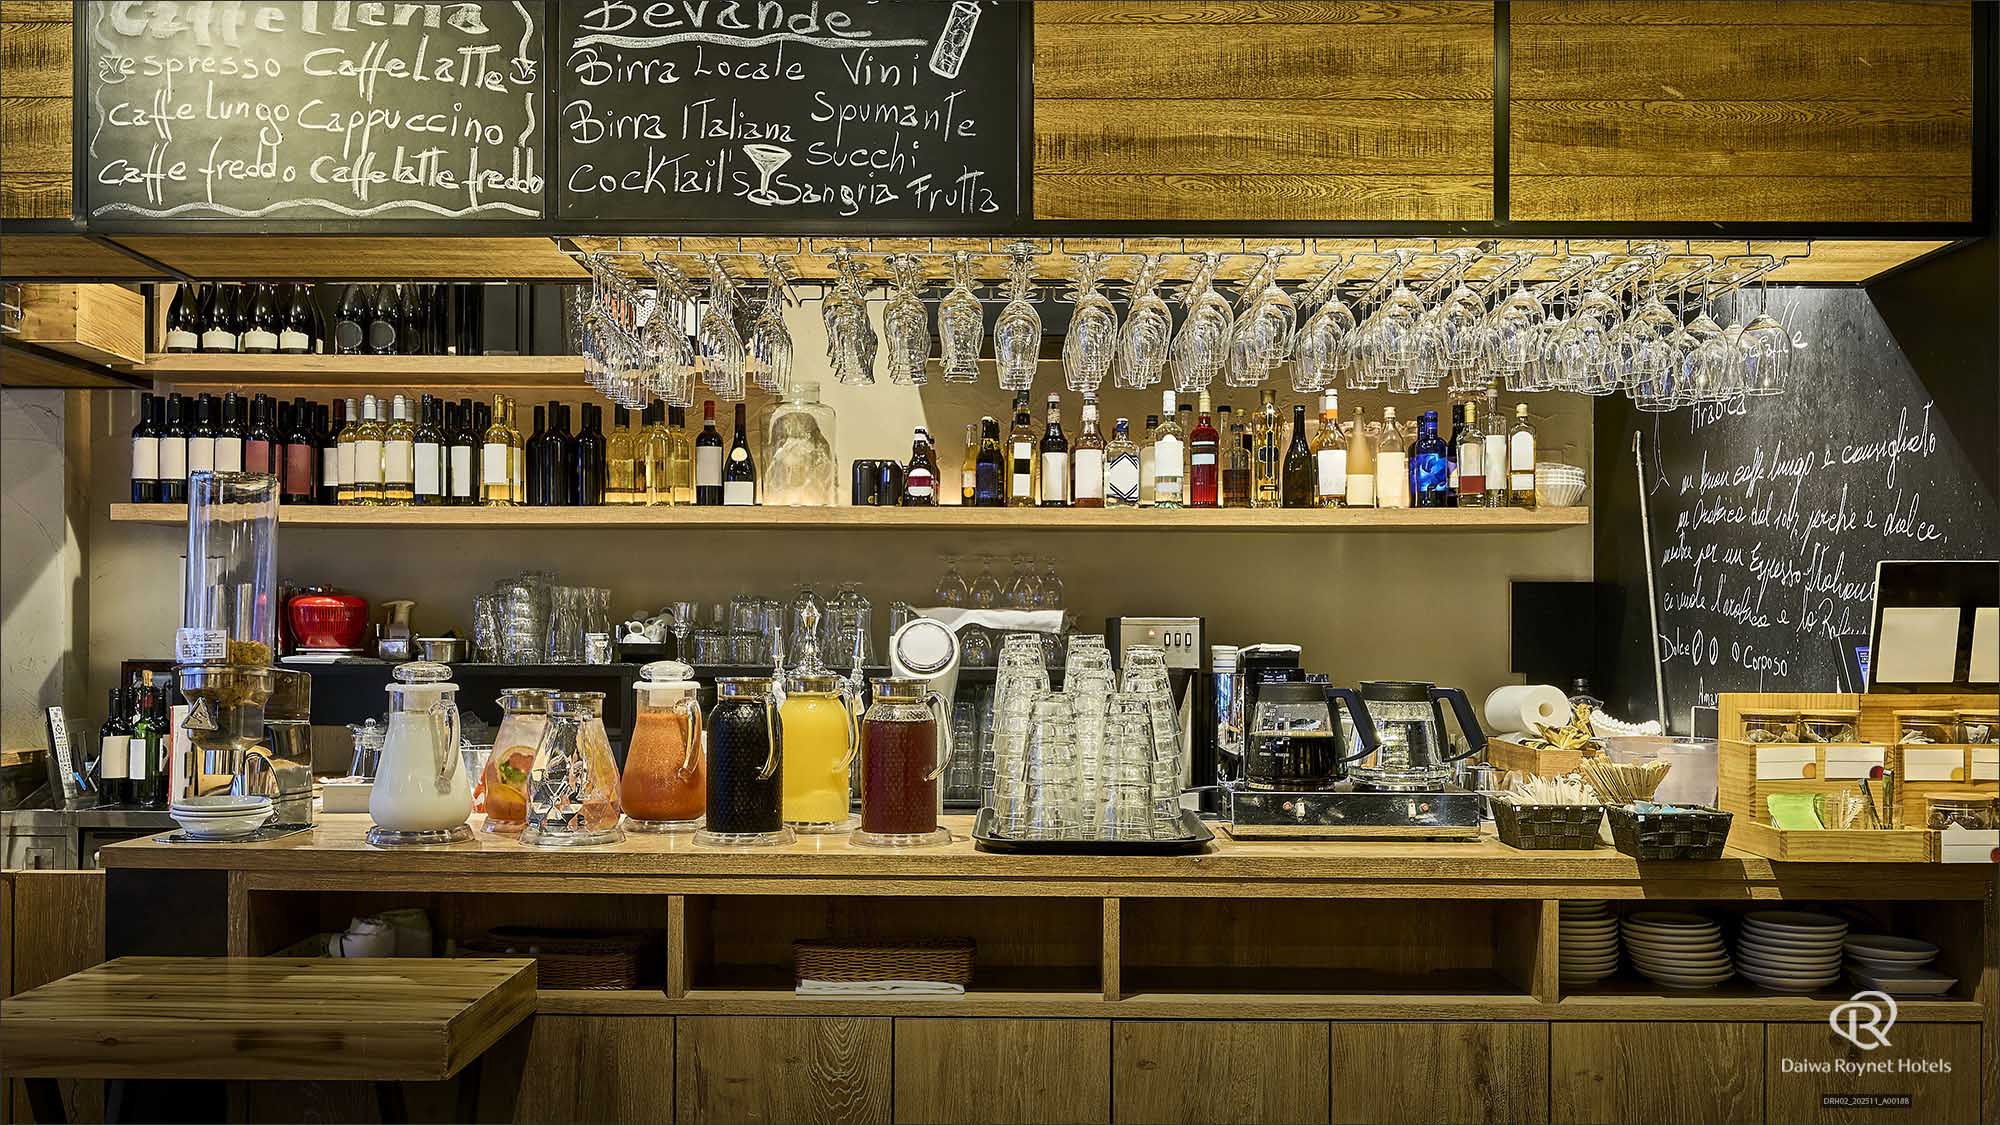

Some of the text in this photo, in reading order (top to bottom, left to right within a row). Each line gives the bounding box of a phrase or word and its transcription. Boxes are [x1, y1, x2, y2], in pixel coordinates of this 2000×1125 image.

[566, 39, 920, 86] Birra Locale Vini
[297, 99, 505, 160] Cappuccino
[562, 99, 667, 144] Birra
[806, 131, 920, 175] Succhi
[775, 172, 900, 216] Sangria
[1743, 645, 1788, 694] Corposo
